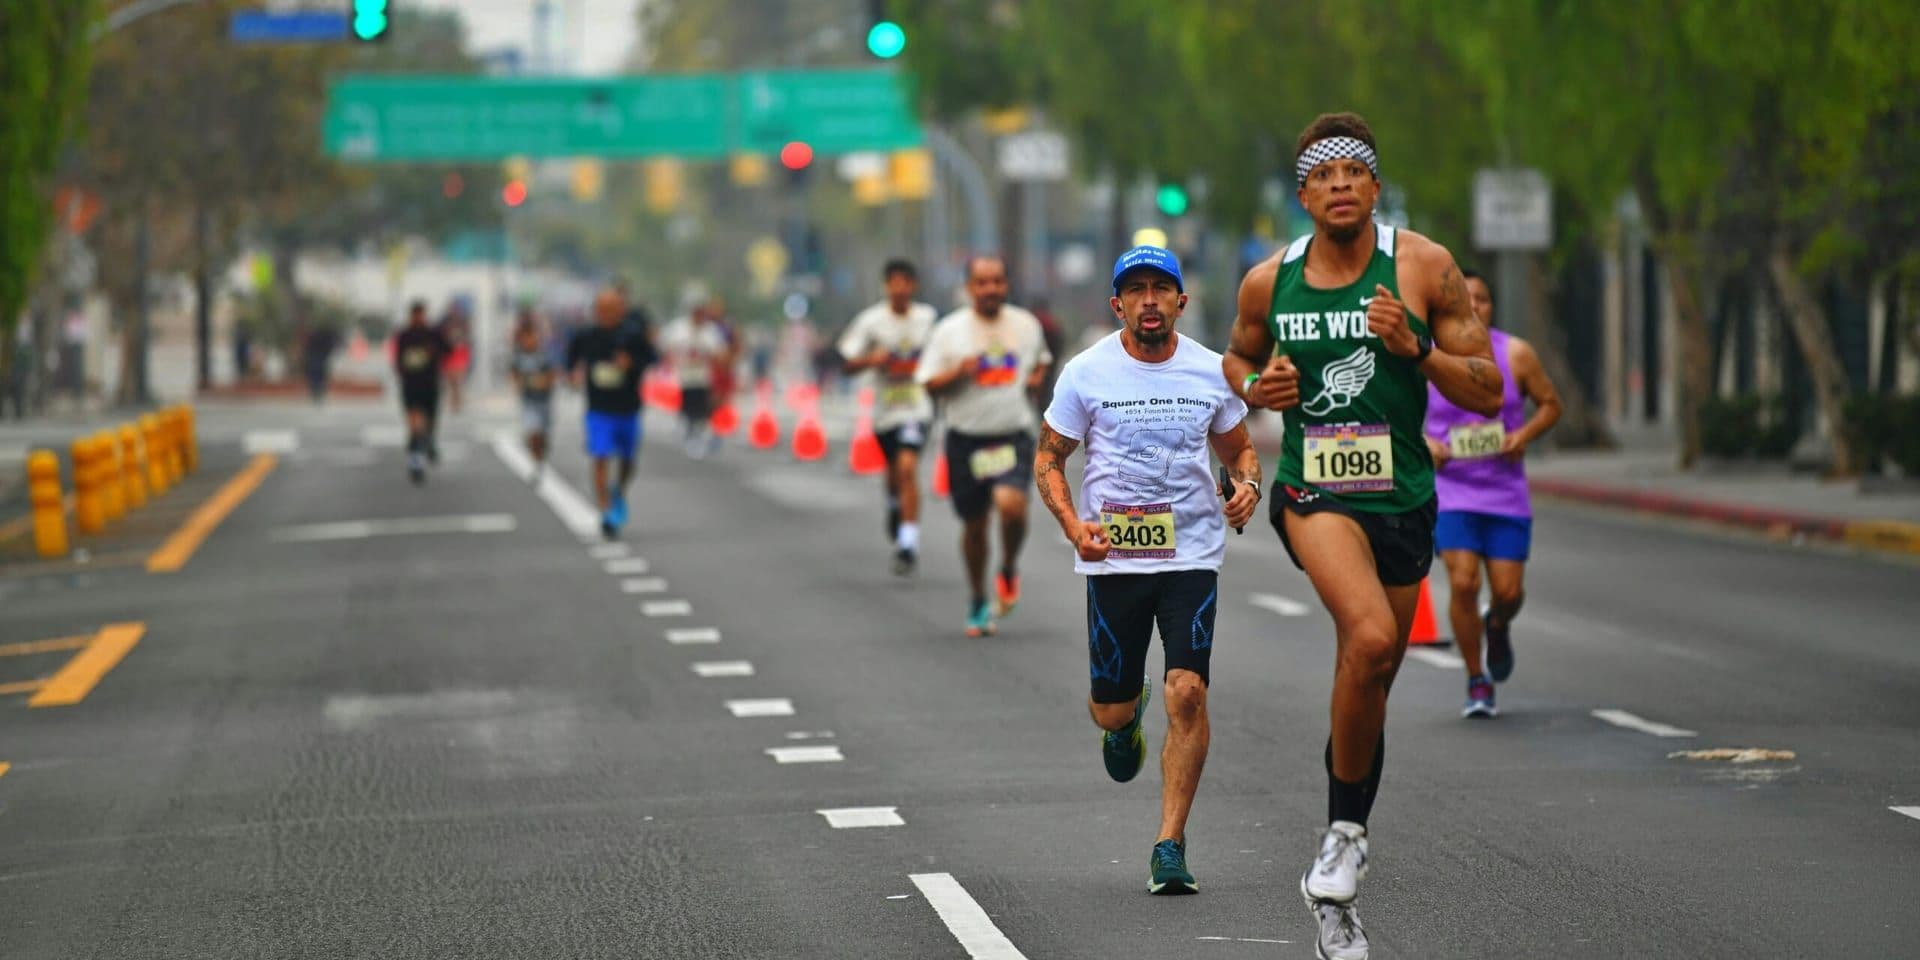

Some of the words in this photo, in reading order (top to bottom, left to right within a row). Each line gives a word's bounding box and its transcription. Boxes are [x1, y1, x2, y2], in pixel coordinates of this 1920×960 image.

[1276, 312, 1320, 340] THE
[1101, 400, 1146, 409] Square
[1177, 397, 1211, 409] Dining
[1314, 450, 1382, 478] 1098
[1109, 524, 1167, 547] 3403
